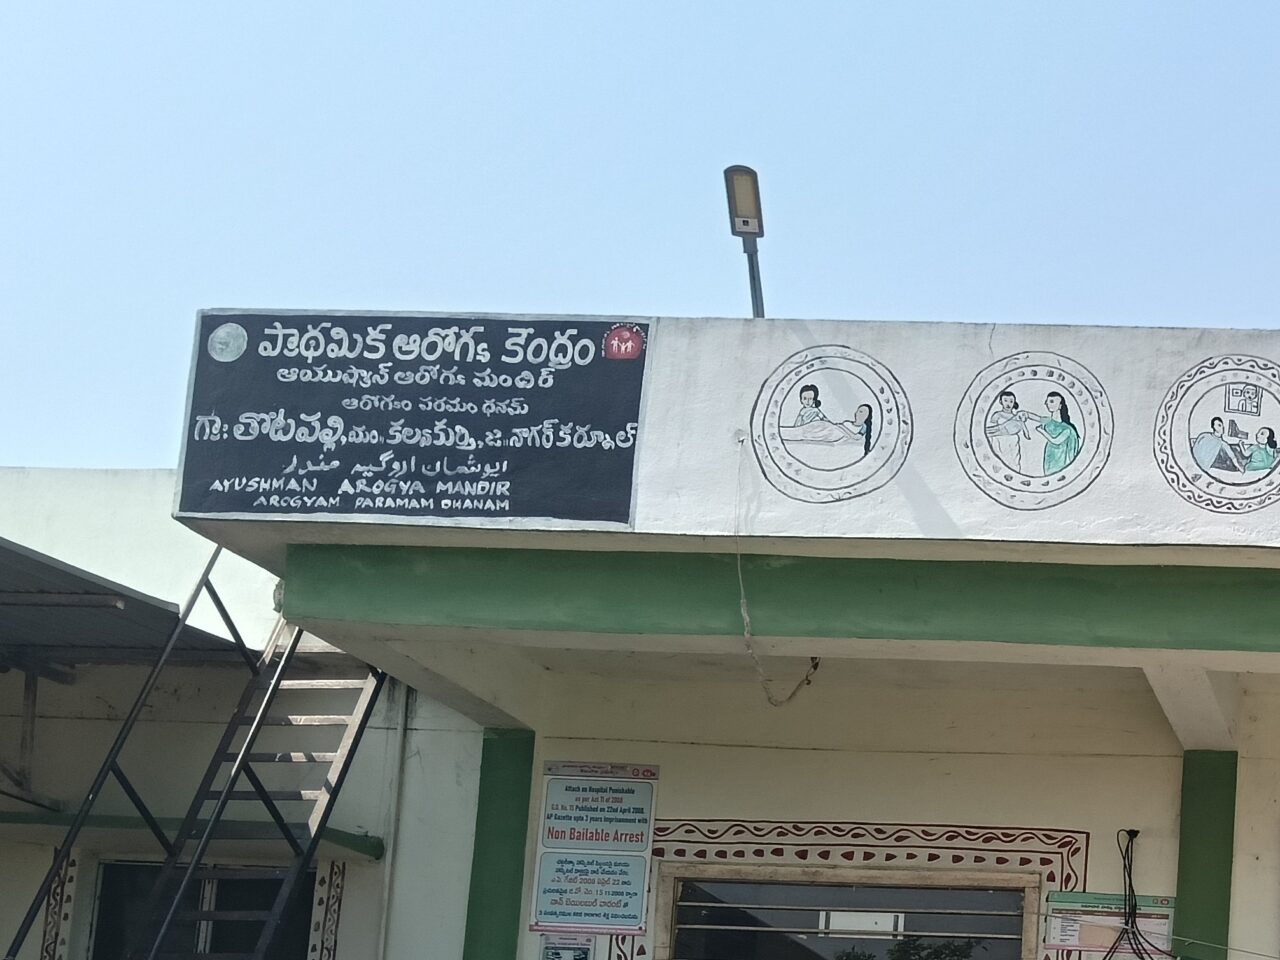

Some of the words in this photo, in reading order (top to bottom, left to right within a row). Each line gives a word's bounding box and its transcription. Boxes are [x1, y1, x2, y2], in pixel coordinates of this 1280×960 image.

[257, 321, 393, 364] ప్రాథమిక
[392, 325, 491, 363] ఆరోగ్య
[501, 327, 596, 370] కేంద్రం
[393, 364, 466, 386] ఆరోగ్య
[472, 366, 556, 389] మందిర్
[209, 476, 318, 492] AYUSHMAN
[337, 478, 425, 495] AROGYA
[436, 480, 512, 496] MANDIR
[253, 495, 340, 509] AROGYAM
[354, 497, 434, 509] PARAMAM
[547, 826, 566, 840] Non
[569, 827, 610, 842] Bailable
[612, 829, 644, 843] Arrest
